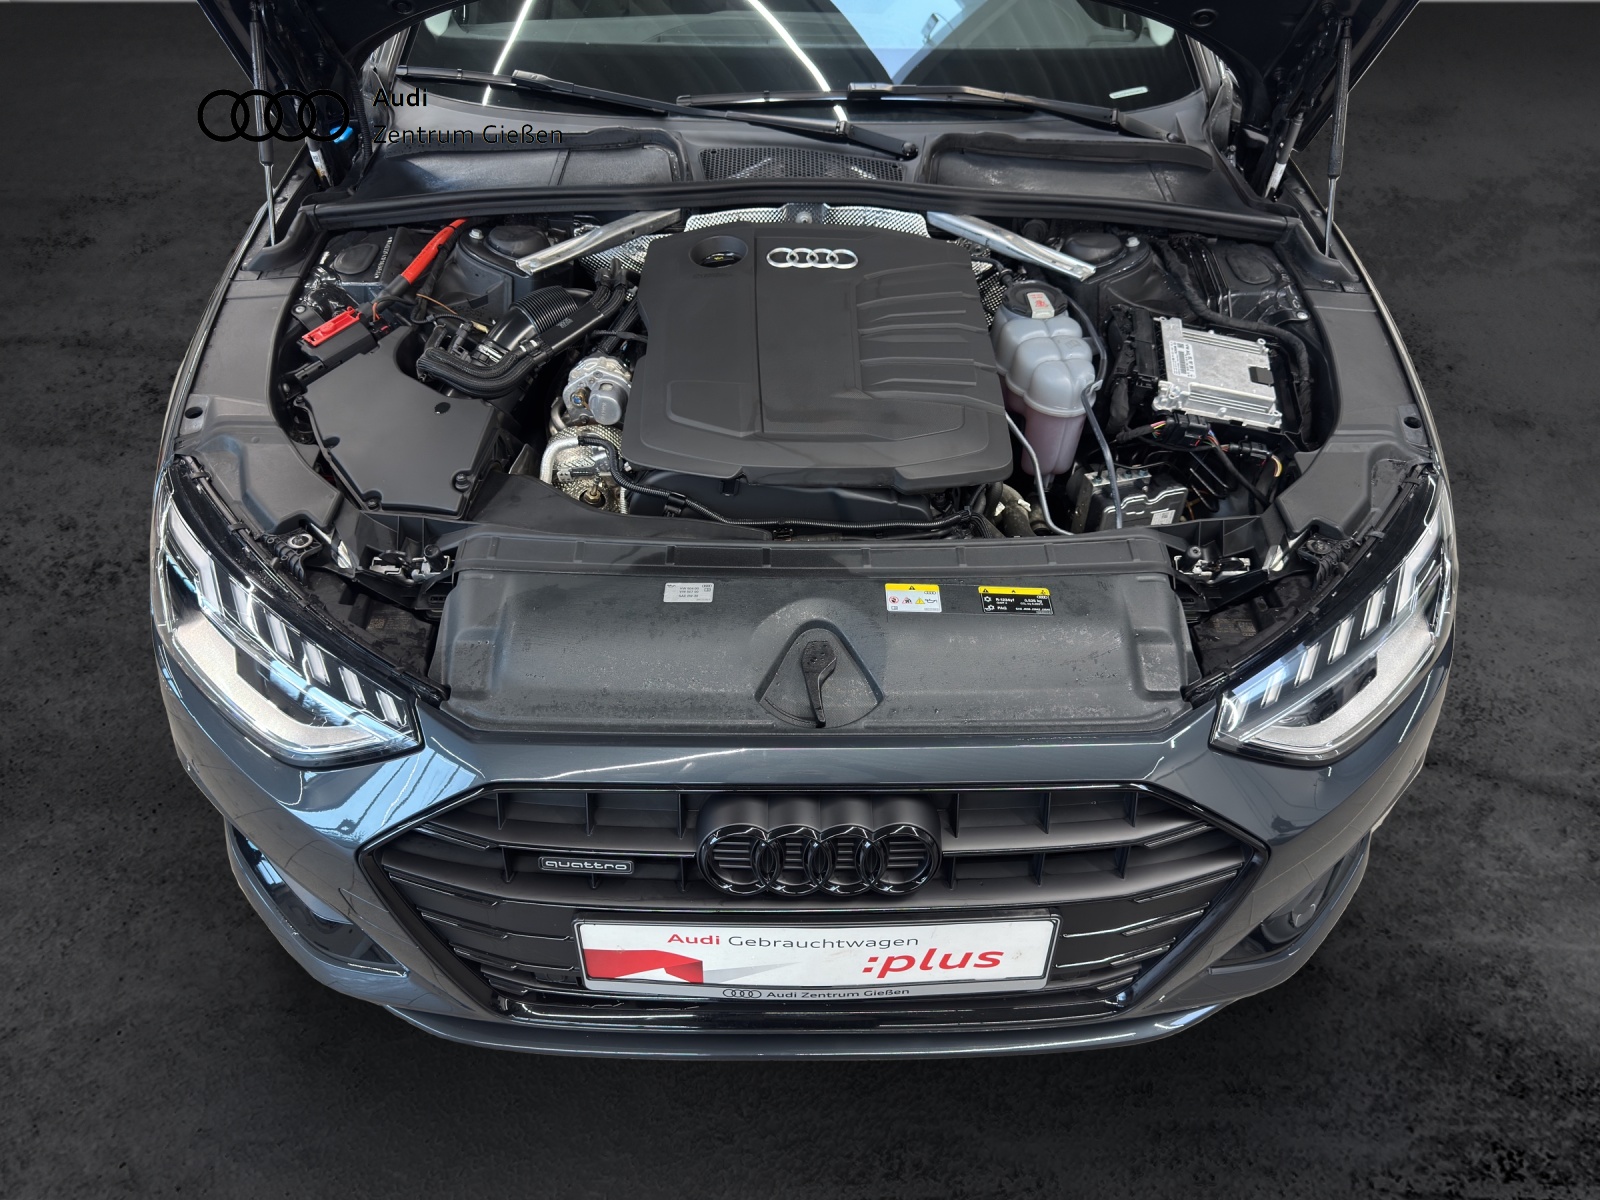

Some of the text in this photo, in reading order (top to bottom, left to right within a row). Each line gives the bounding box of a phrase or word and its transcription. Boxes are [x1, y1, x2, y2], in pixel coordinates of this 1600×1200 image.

[545, 860, 628, 870] quattro
[667, 933, 919, 950] Audi Gebrauchtwagen
[862, 948, 1005, 979] :plus
[766, 988, 910, 999] Audi Zentrum Gießen
